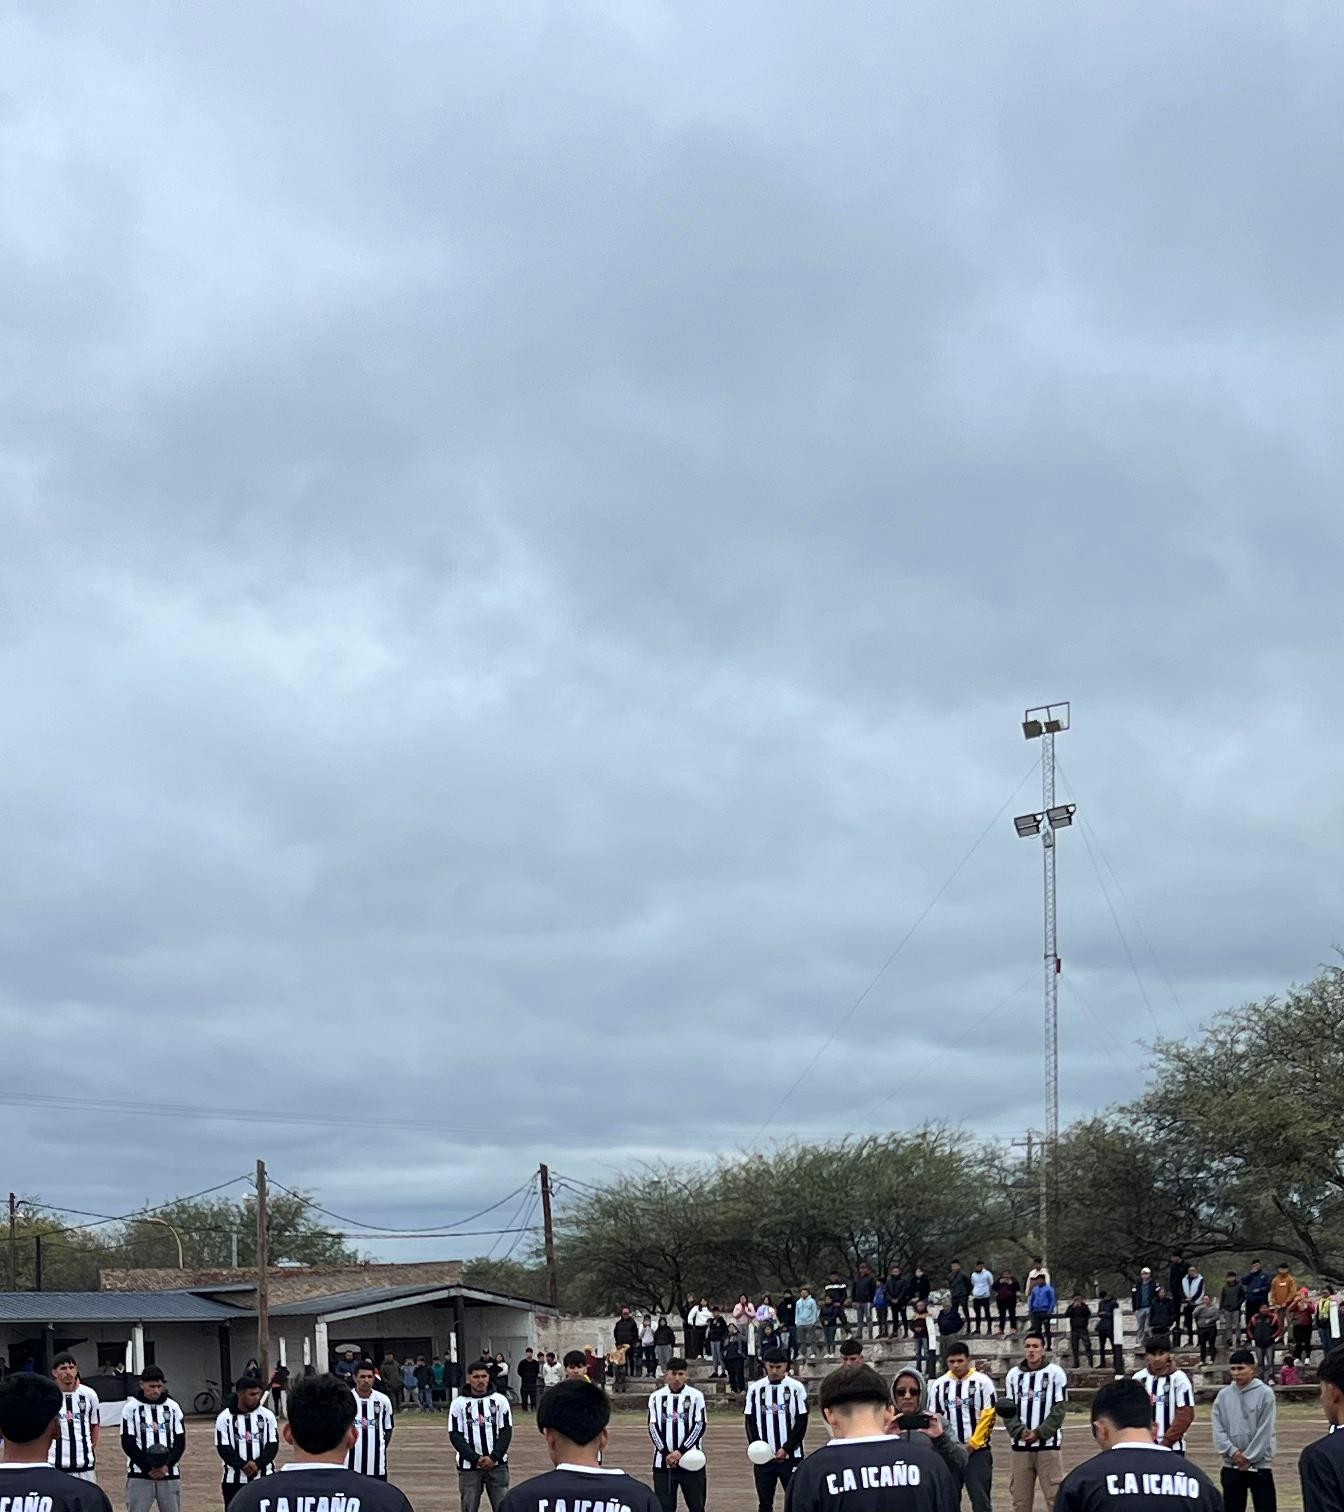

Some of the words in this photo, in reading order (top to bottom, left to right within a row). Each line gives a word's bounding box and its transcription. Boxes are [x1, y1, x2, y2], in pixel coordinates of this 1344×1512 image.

[826, 1468, 858, 1495] C.A
[860, 1460, 921, 1489] ICAÑO
[1106, 1472, 1139, 1496] C.A
[1142, 1471, 1200, 1499] ICAÑO
